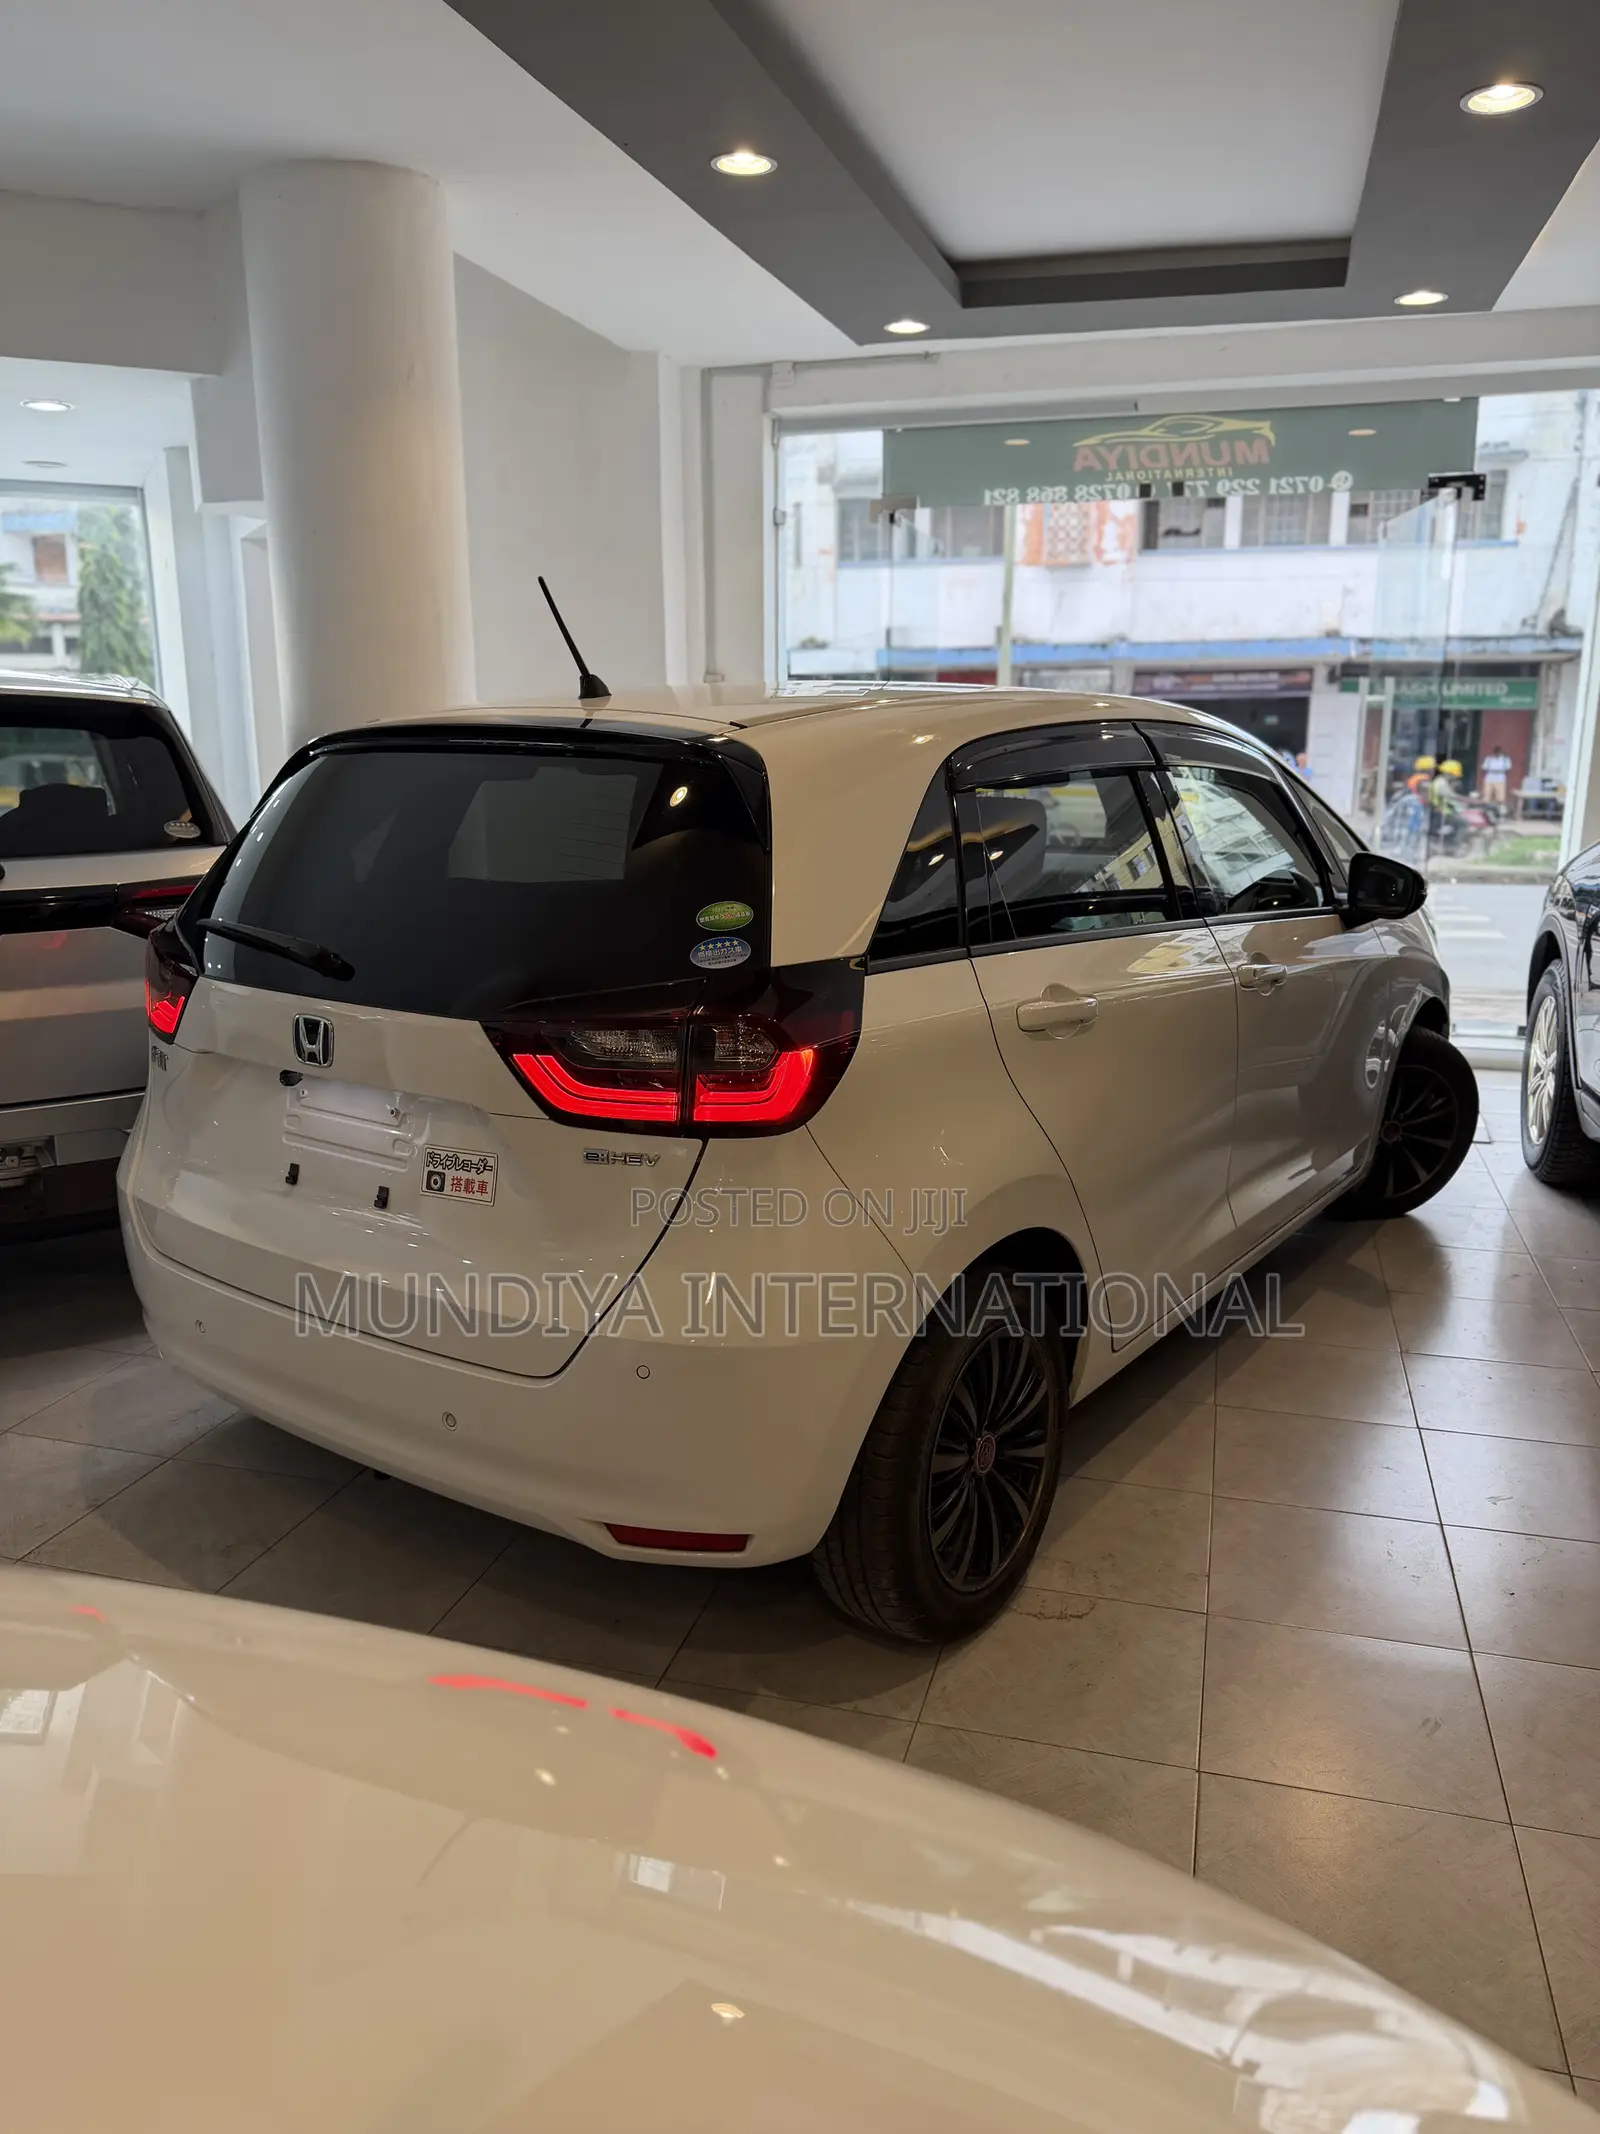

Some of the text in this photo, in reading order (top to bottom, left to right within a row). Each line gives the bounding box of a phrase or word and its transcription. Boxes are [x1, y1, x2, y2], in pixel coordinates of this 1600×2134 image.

[425, 1151, 494, 1176] ドライブレコーダー
[450, 1175, 489, 1196] 搭載車
